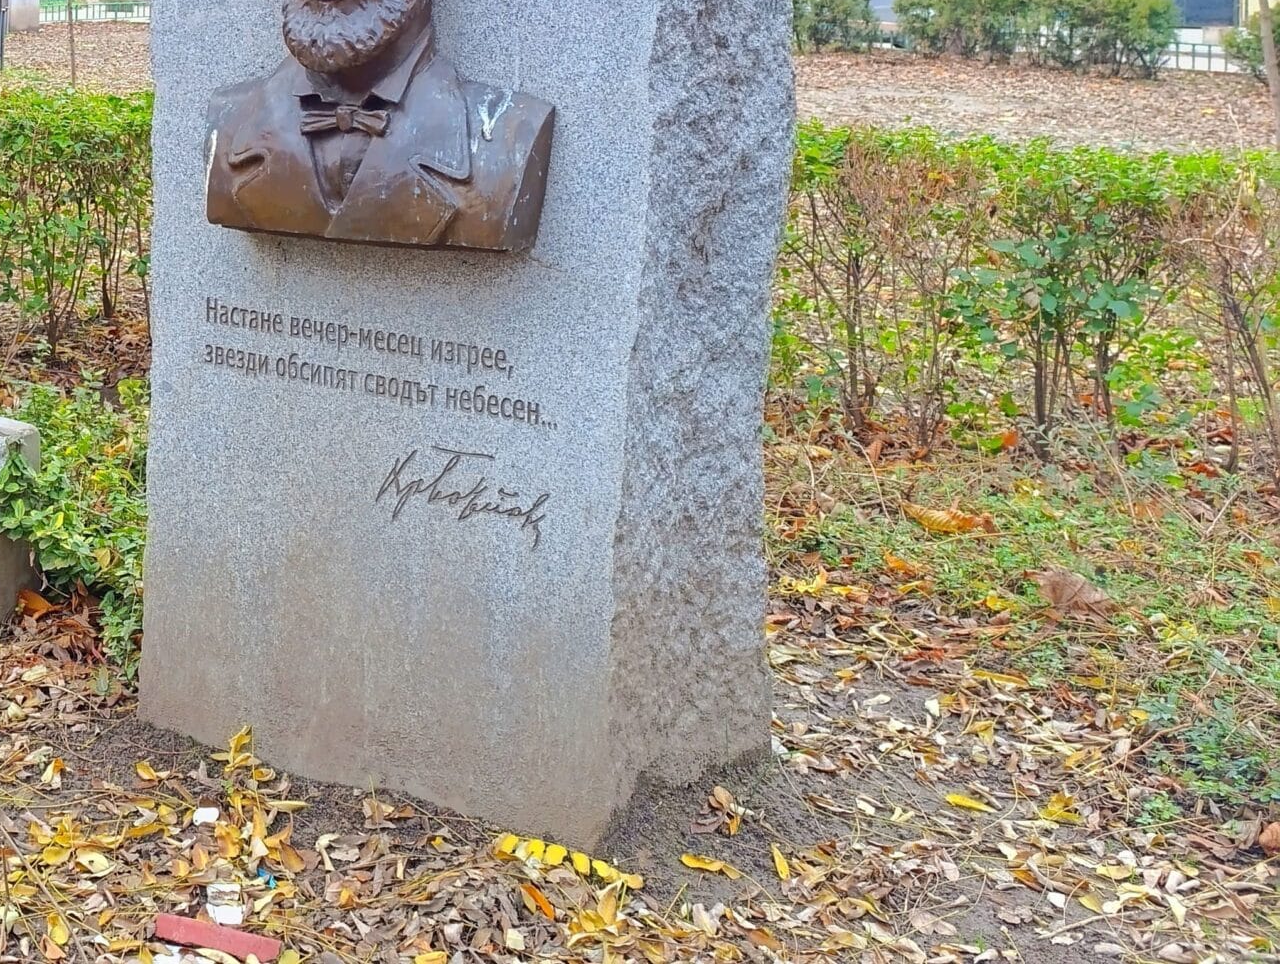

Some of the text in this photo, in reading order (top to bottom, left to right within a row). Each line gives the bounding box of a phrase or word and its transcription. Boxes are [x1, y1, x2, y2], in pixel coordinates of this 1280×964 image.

[205, 296, 515, 379] Настане вечер-месец изгрее,
[204, 344, 559, 430] звезди обсипят сводът небесен...
